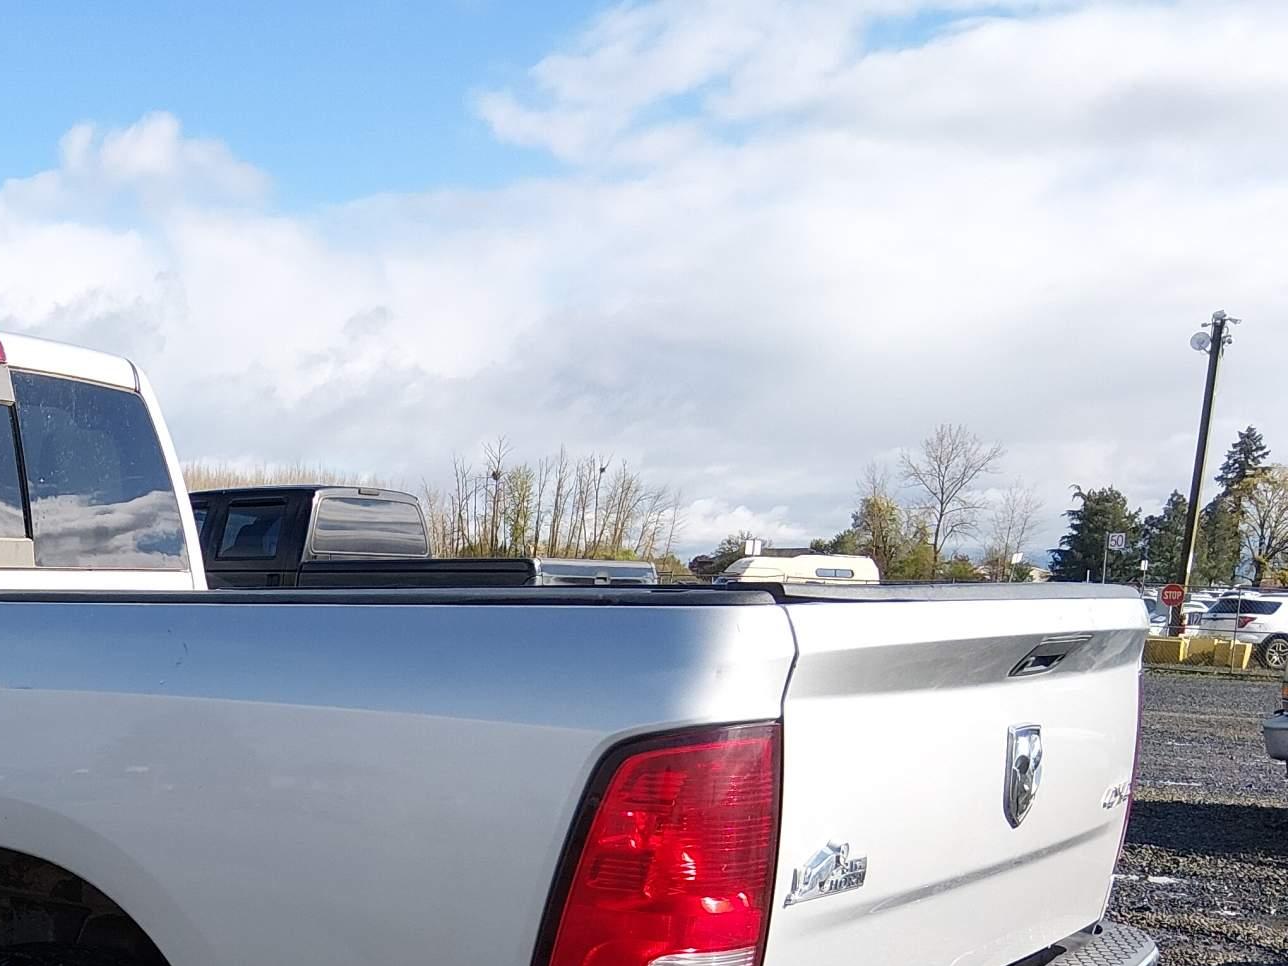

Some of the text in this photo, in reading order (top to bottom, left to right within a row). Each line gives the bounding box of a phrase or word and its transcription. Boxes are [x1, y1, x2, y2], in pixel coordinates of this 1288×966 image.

[1109, 534, 1124, 548] 50
[1162, 590, 1182, 601] STOP
[828, 869, 865, 891] HORN
